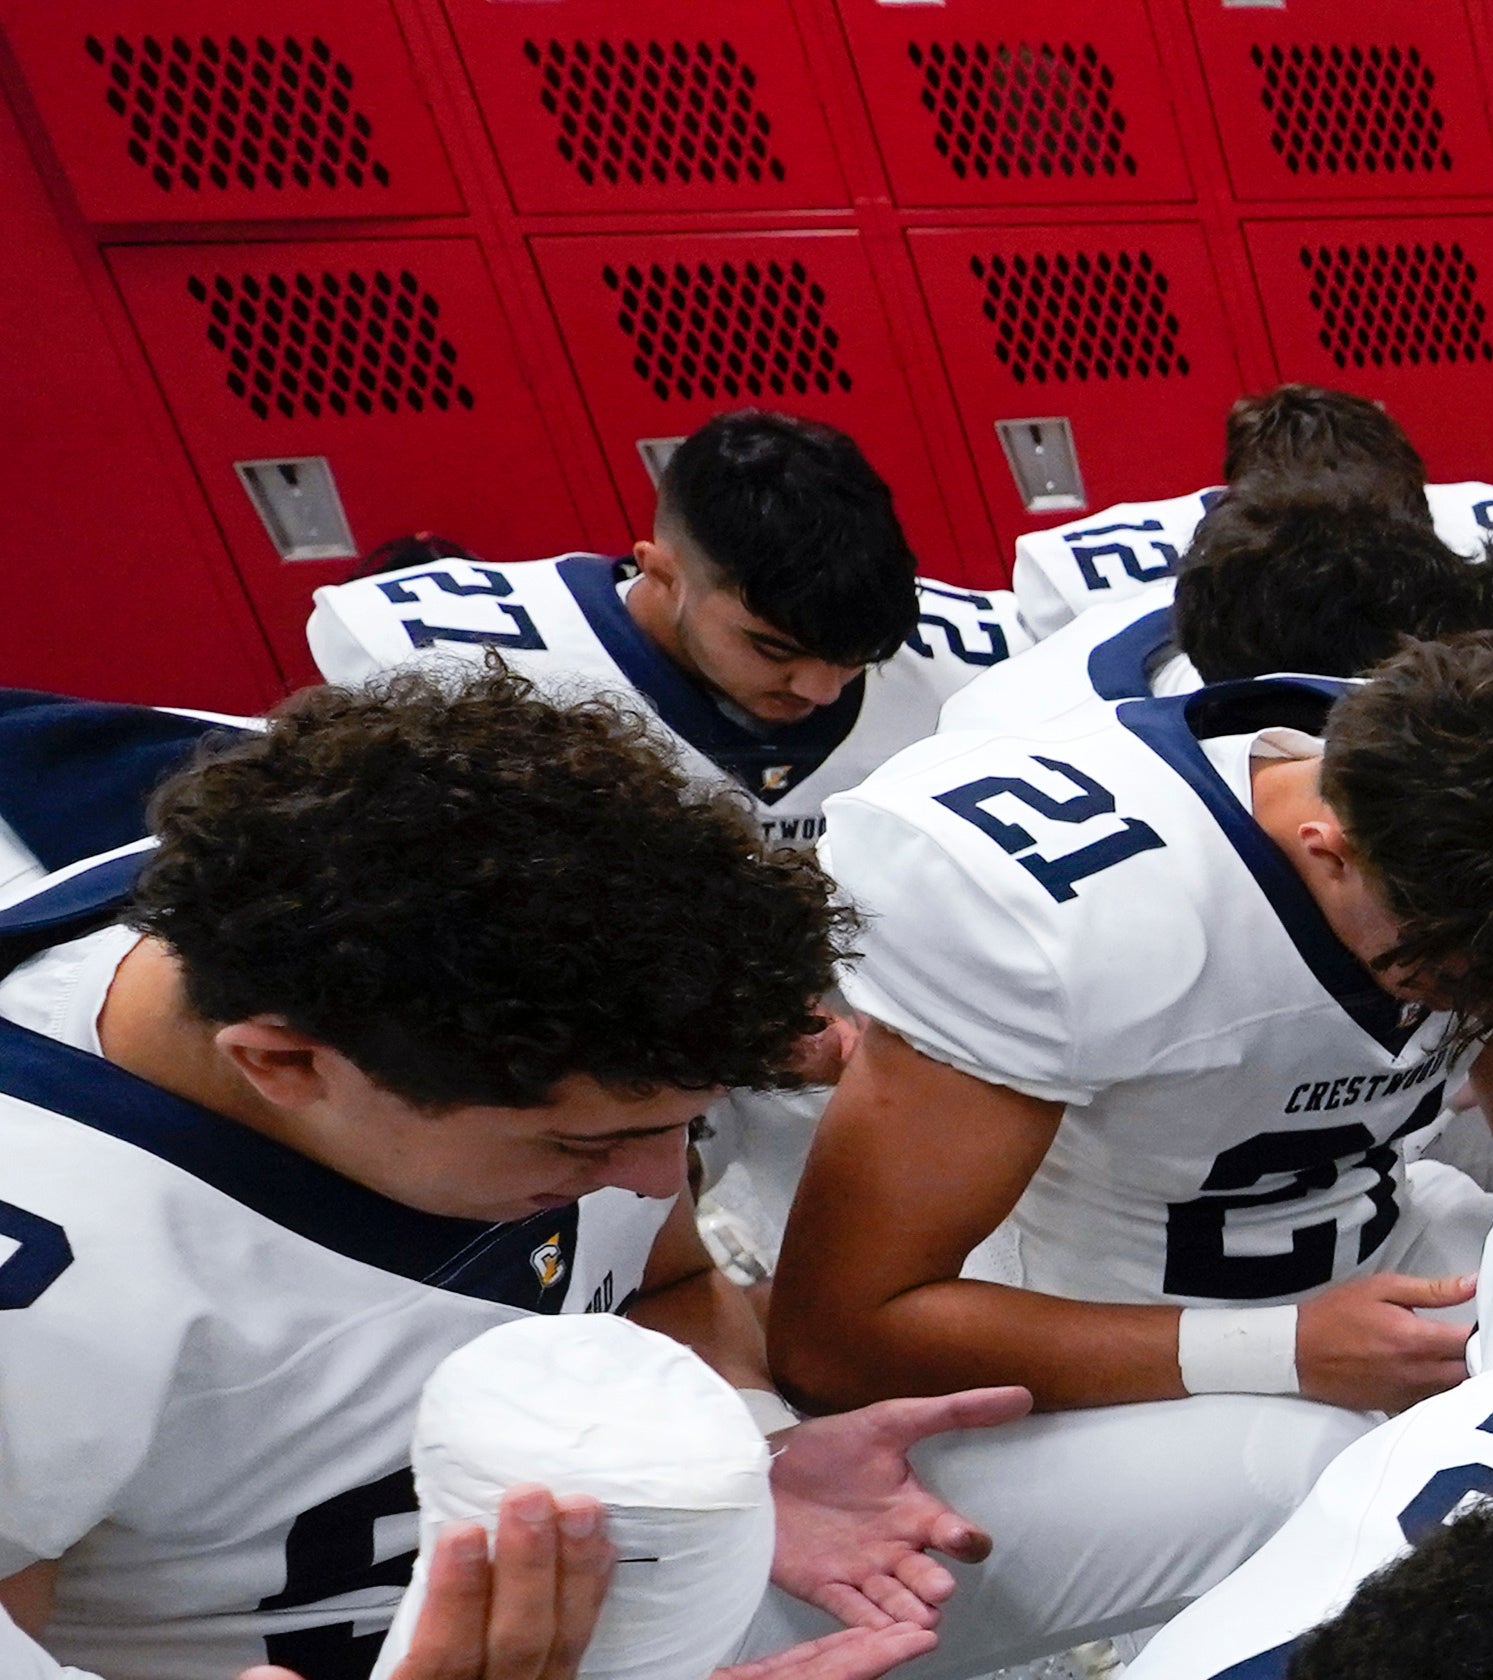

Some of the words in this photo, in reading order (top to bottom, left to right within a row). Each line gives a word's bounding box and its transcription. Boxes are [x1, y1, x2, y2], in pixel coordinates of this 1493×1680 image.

[1063, 518, 1179, 591] 12
[378, 566, 547, 650] 27
[932, 754, 1168, 904] 21
[1284, 1046, 1449, 1114] CRESTWOOD
